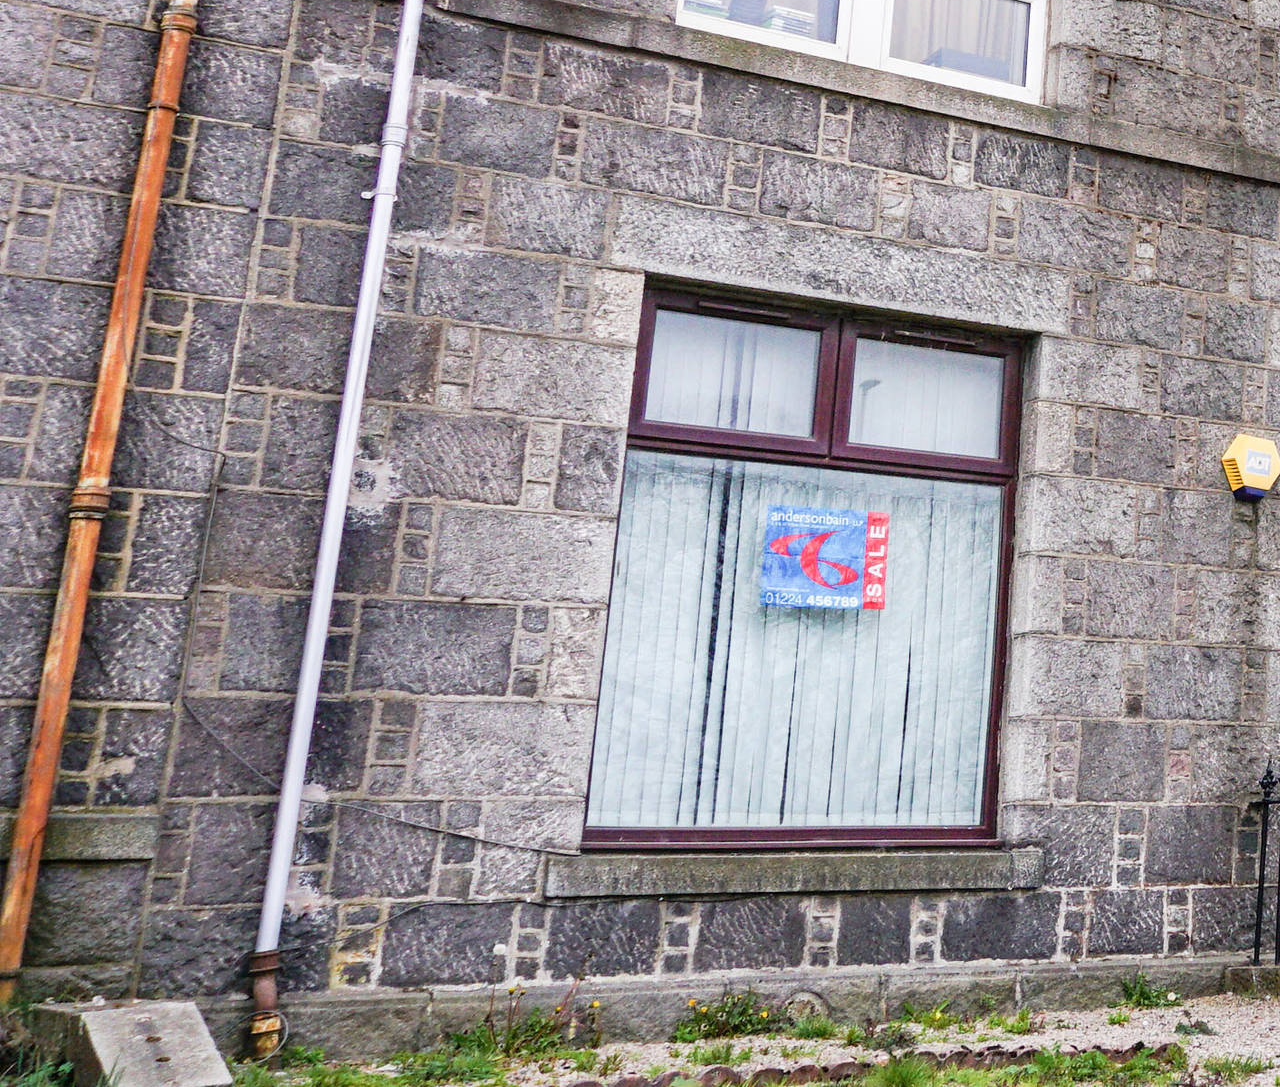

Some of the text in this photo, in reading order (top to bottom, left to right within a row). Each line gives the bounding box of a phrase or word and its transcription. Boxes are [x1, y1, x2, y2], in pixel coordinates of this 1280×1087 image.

[1248, 456, 1270, 471] ADT
[771, 510, 849, 526] andersonbain
[867, 525, 886, 597] SALE
[766, 592, 858, 607] 01224 456789
